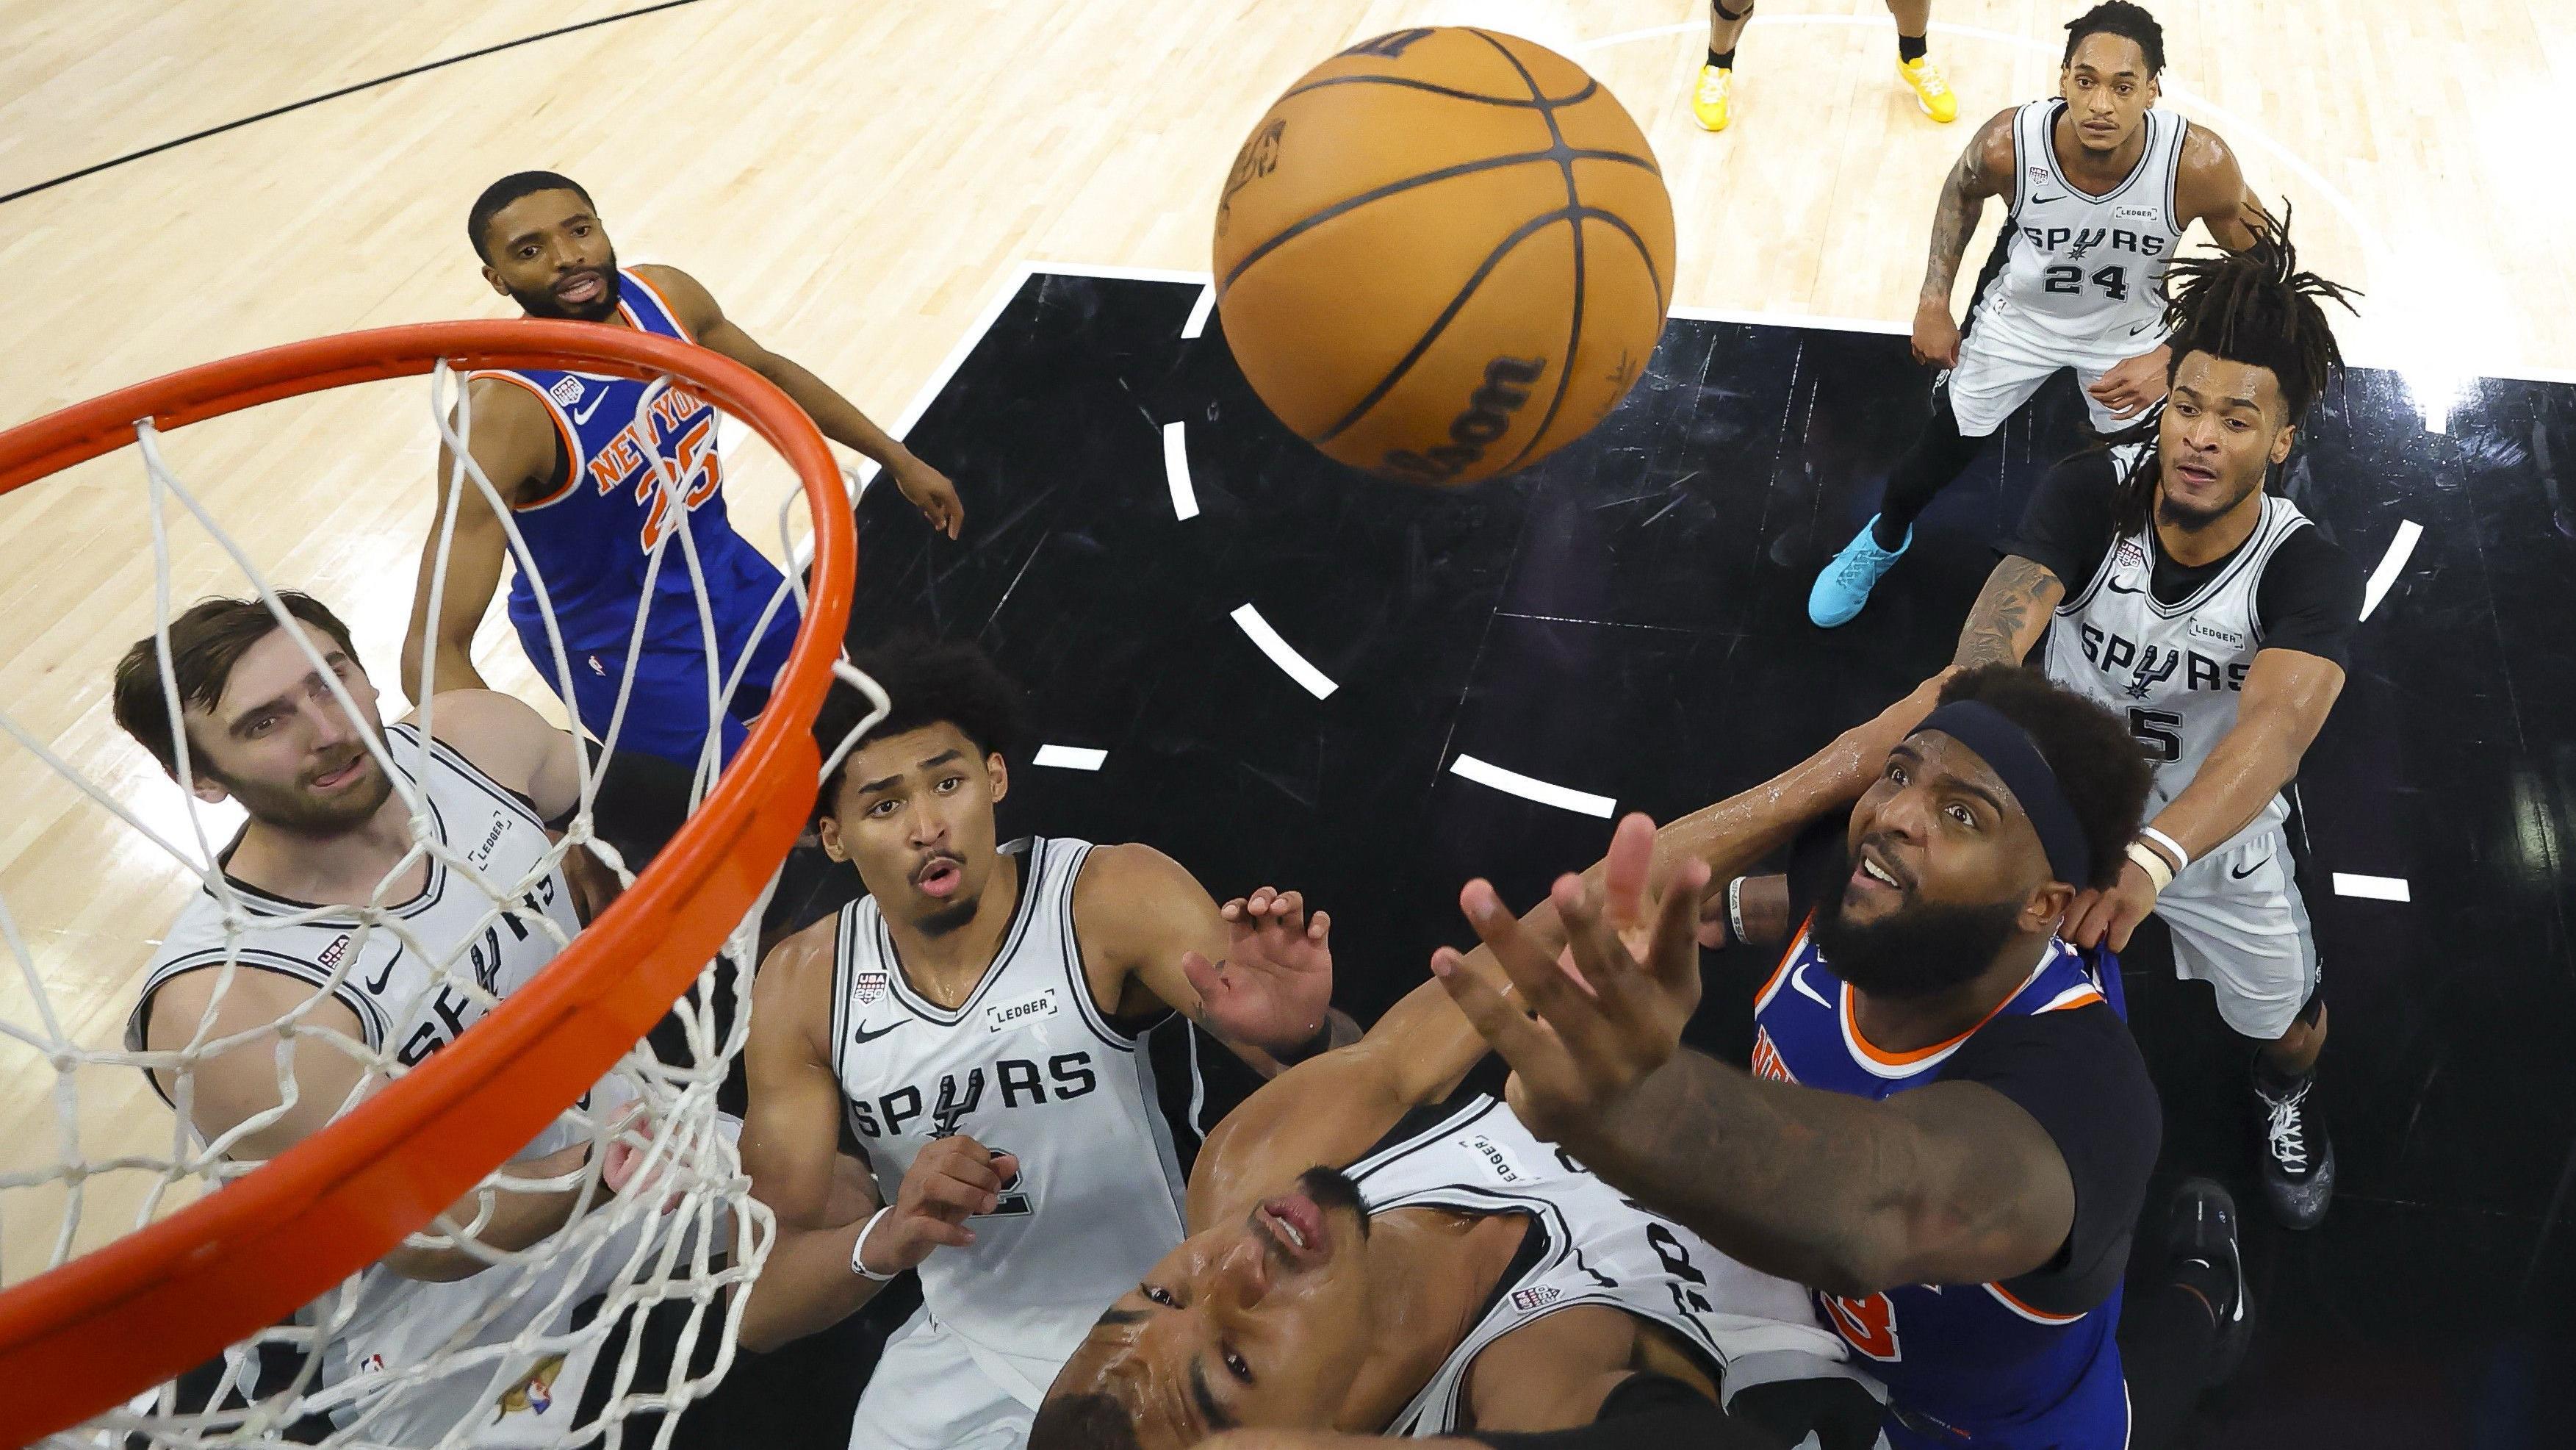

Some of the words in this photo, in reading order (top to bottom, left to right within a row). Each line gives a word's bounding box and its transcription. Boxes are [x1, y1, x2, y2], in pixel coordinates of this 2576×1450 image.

[2121, 209, 2152, 218] LEDGER
[2023, 226, 2165, 260] SPURS
[2043, 264, 2128, 303] 24
[650, 387, 709, 434] YO
[2195, 625, 2237, 645] LEDGER
[2127, 707, 2184, 764] 5
[477, 820, 505, 861] LEDGER
[855, 988, 884, 999] 250
[860, 975, 885, 984] USA
[996, 998, 1049, 1024] LEDGER
[851, 1050, 1097, 1139] SPURS
[1475, 1141, 1525, 1182] EDGER
